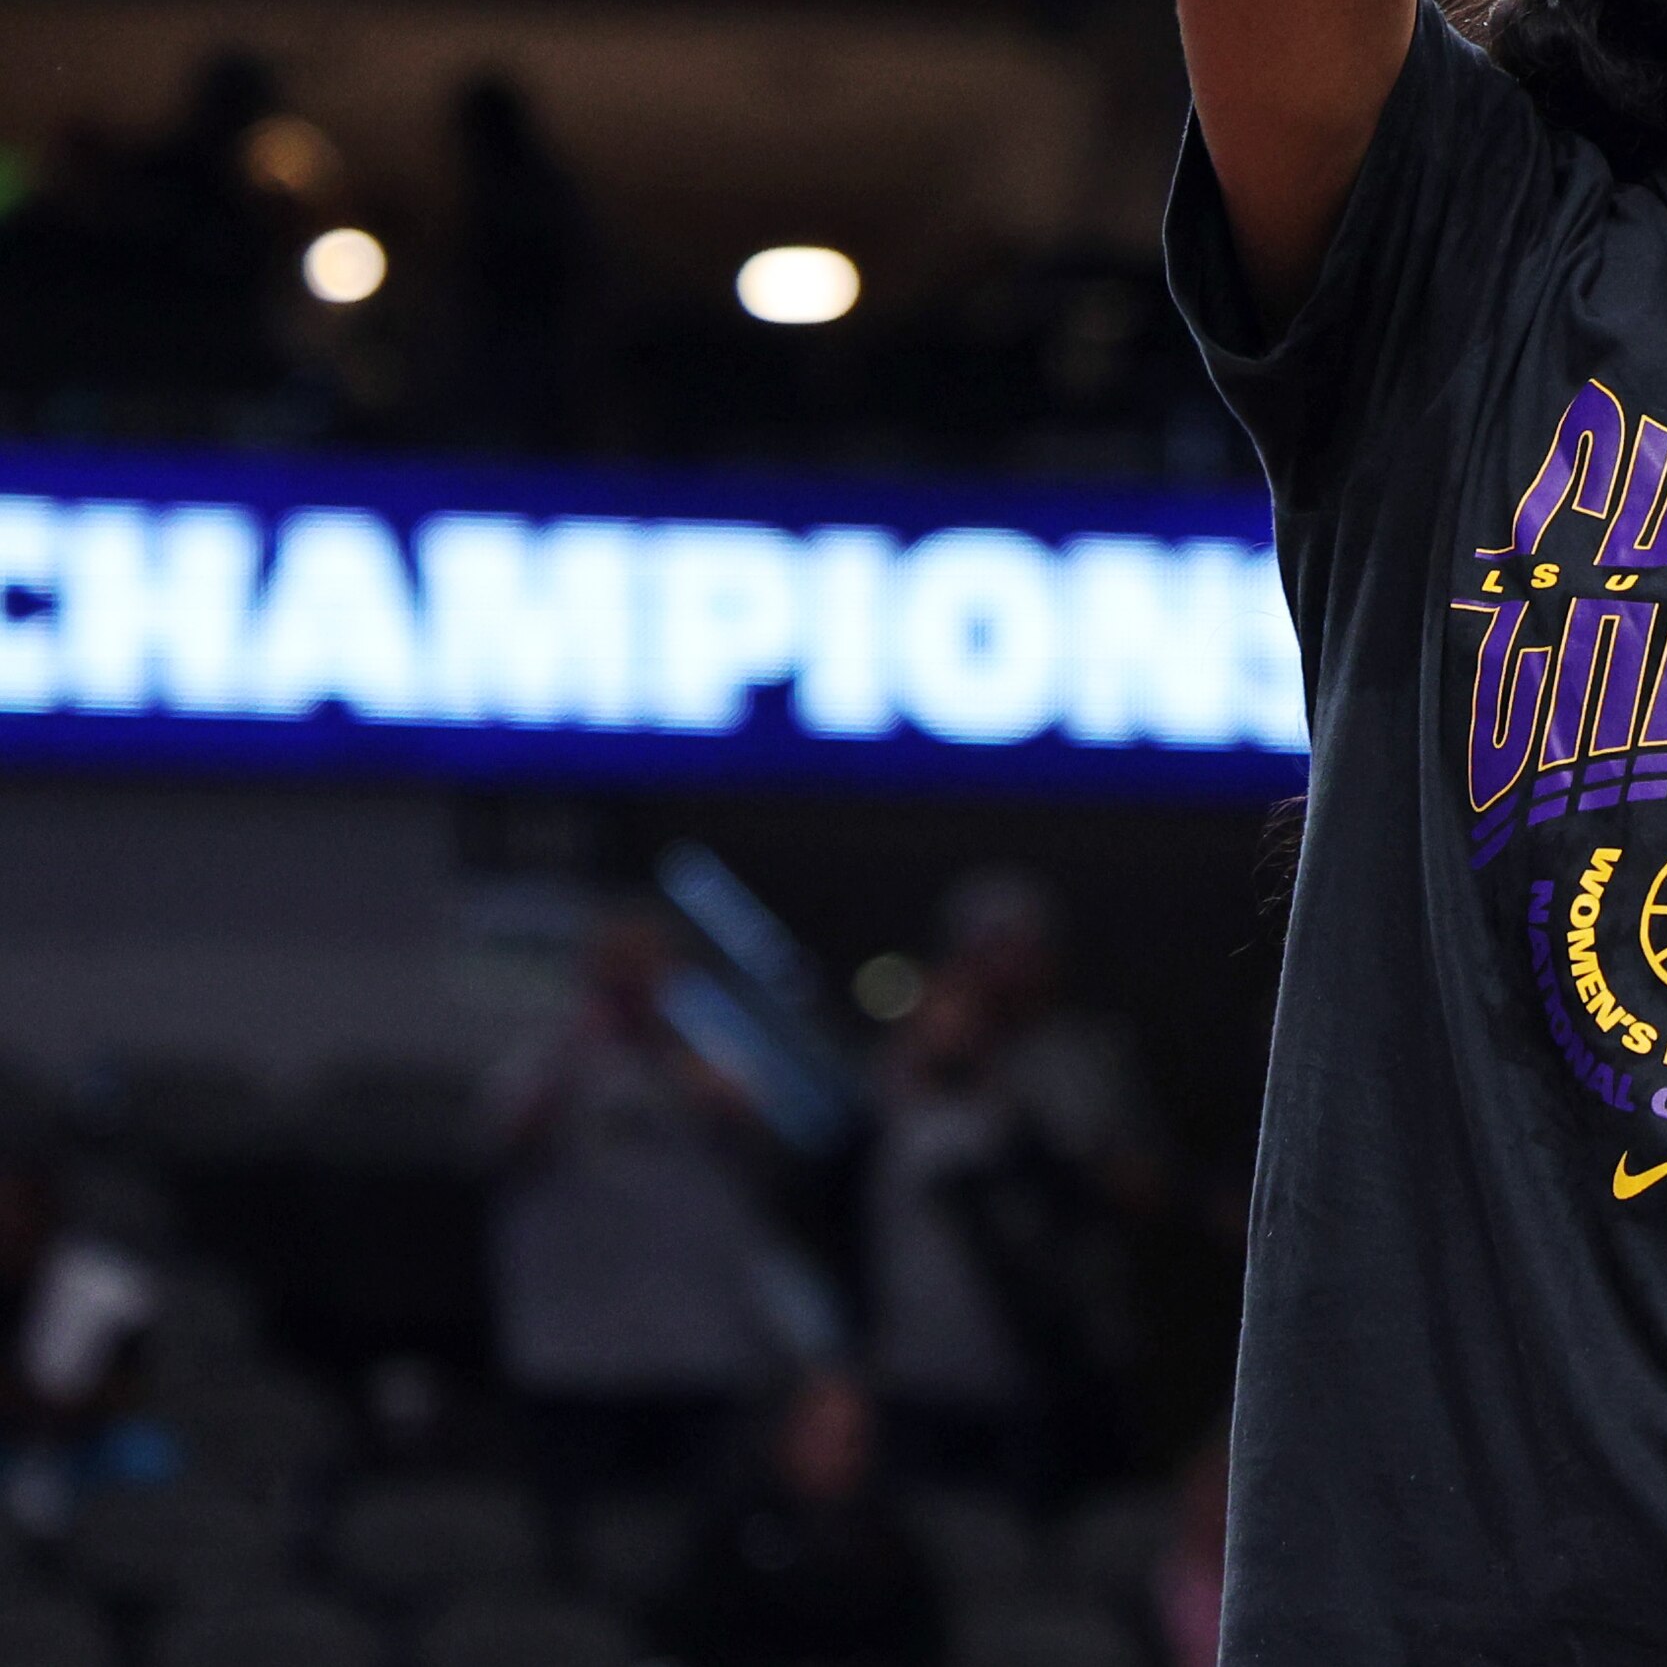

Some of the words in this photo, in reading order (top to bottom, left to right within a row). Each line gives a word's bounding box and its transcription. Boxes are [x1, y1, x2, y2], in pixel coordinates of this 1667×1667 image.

[1482, 563, 1639, 593] LSU
[1527, 879, 1637, 1112] NATIONAL
[1566, 847, 1658, 1055] WOMEN'S
